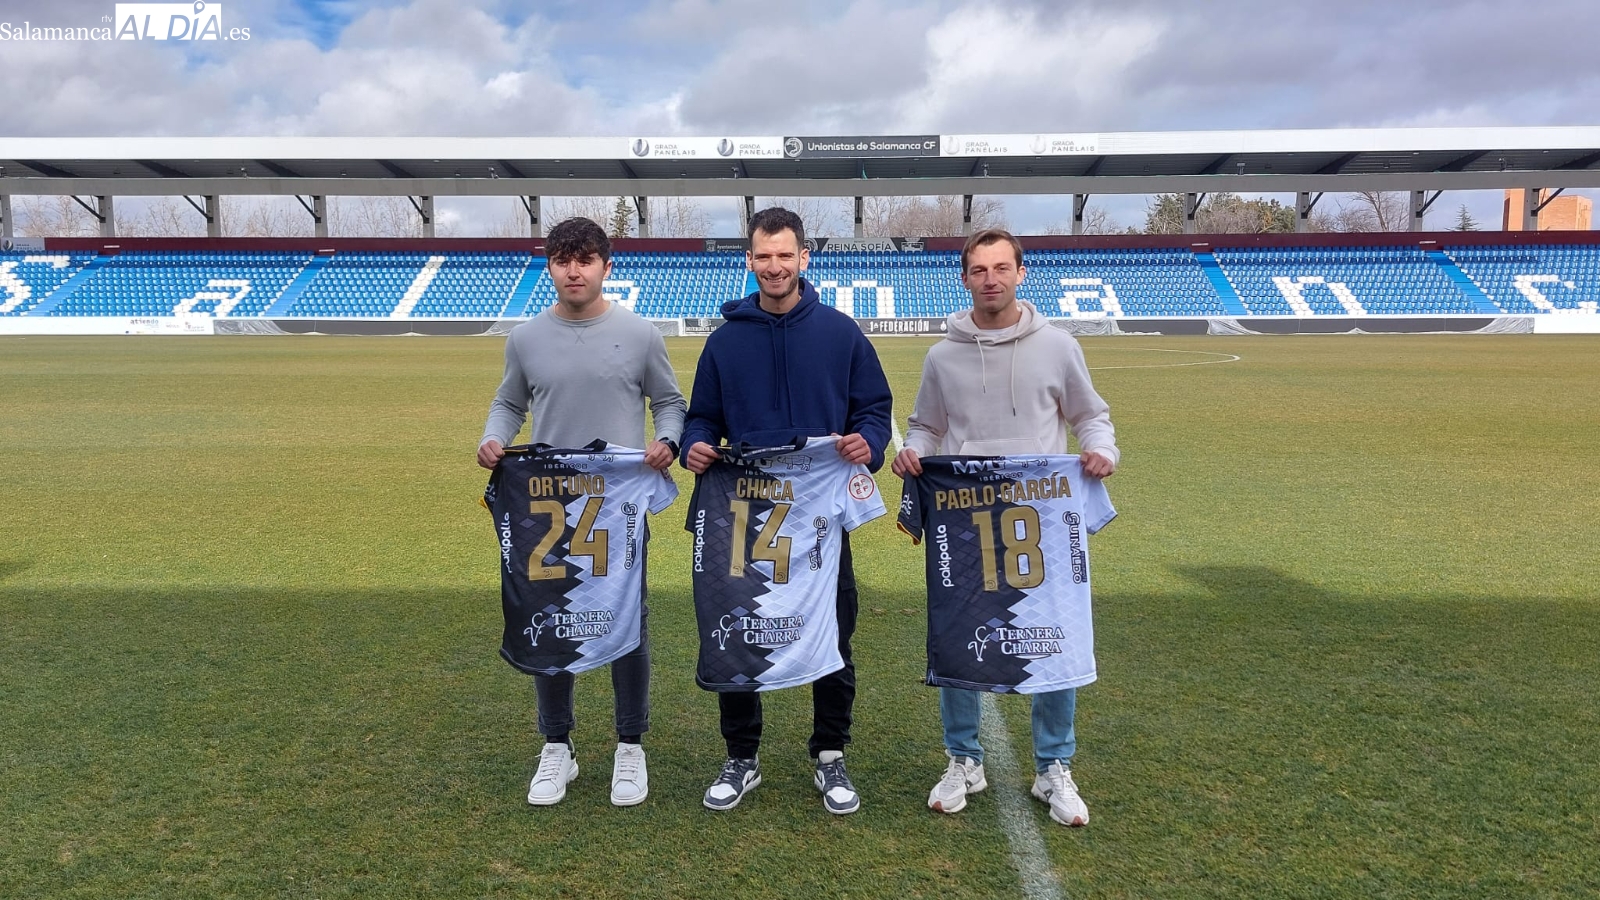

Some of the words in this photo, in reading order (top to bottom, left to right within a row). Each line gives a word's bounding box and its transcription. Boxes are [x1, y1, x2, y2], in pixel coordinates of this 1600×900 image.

[807, 142, 852, 151] Unionistas
[855, 142, 869, 151] de
[869, 141, 921, 151] Salamanca
[923, 141, 936, 150] CF
[827, 243, 857, 251] REINA
[861, 241, 892, 251] SOFÍA
[880, 319, 930, 332] FEDERACIÓN
[736, 477, 794, 501] CHUCA
[935, 484, 996, 511] PABLO
[1000, 471, 1072, 503] GARCÍA
[528, 497, 609, 581] 24
[693, 509, 706, 572] pakipalla
[729, 499, 792, 584] 14
[972, 505, 1045, 592] 18
[1062, 510, 1082, 585] GUINALDO
[935, 524, 955, 588] pakipalla
[551, 610, 614, 626] TERNERA
[740, 615, 805, 630] TERNERA
[555, 624, 611, 639] CHARRA
[743, 629, 802, 645] CHARRA
[996, 627, 1065, 641] TERNERA
[1001, 641, 1062, 656] CHARRA
